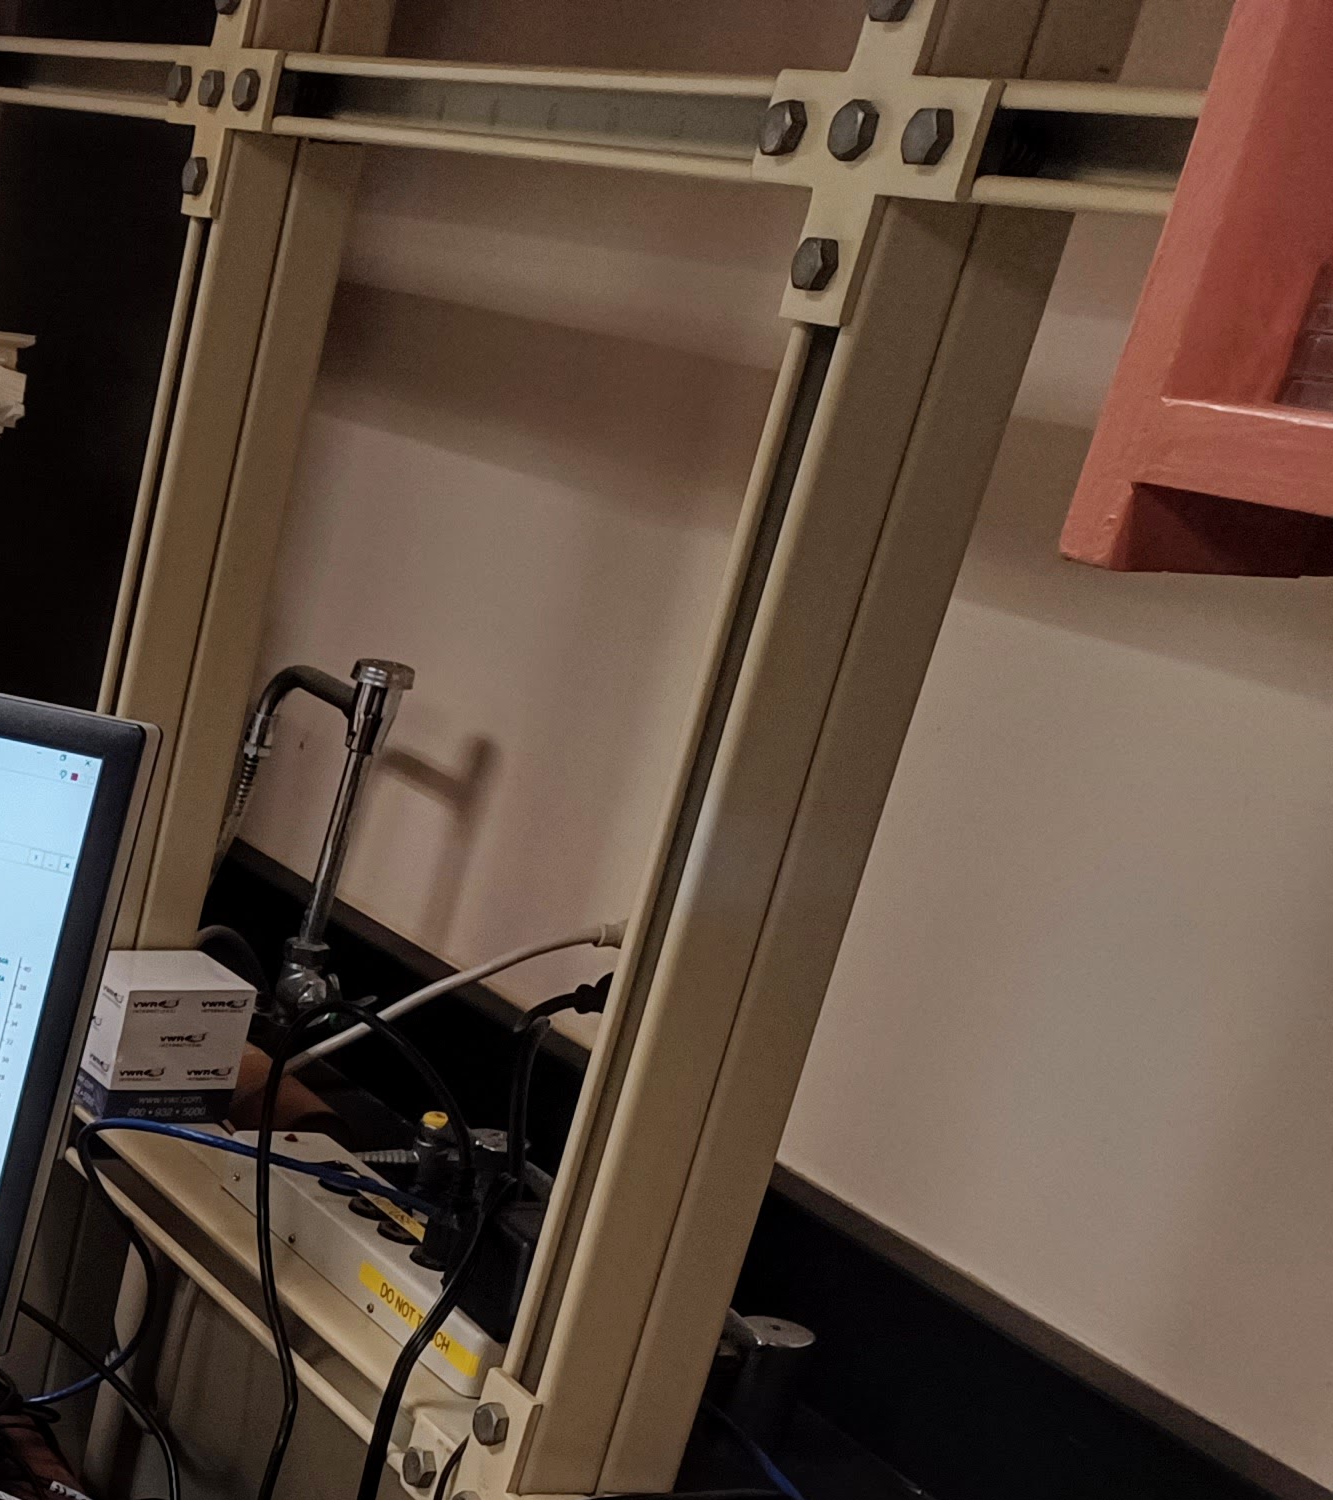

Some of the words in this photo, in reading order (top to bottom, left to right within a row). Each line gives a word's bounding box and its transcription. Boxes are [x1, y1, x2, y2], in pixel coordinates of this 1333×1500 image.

[127, 1106, 147, 1117] 800
[379, 1282, 395, 1305] DO
[395, 1293, 417, 1320] NOT
[417, 1315, 451, 1354] TCH
